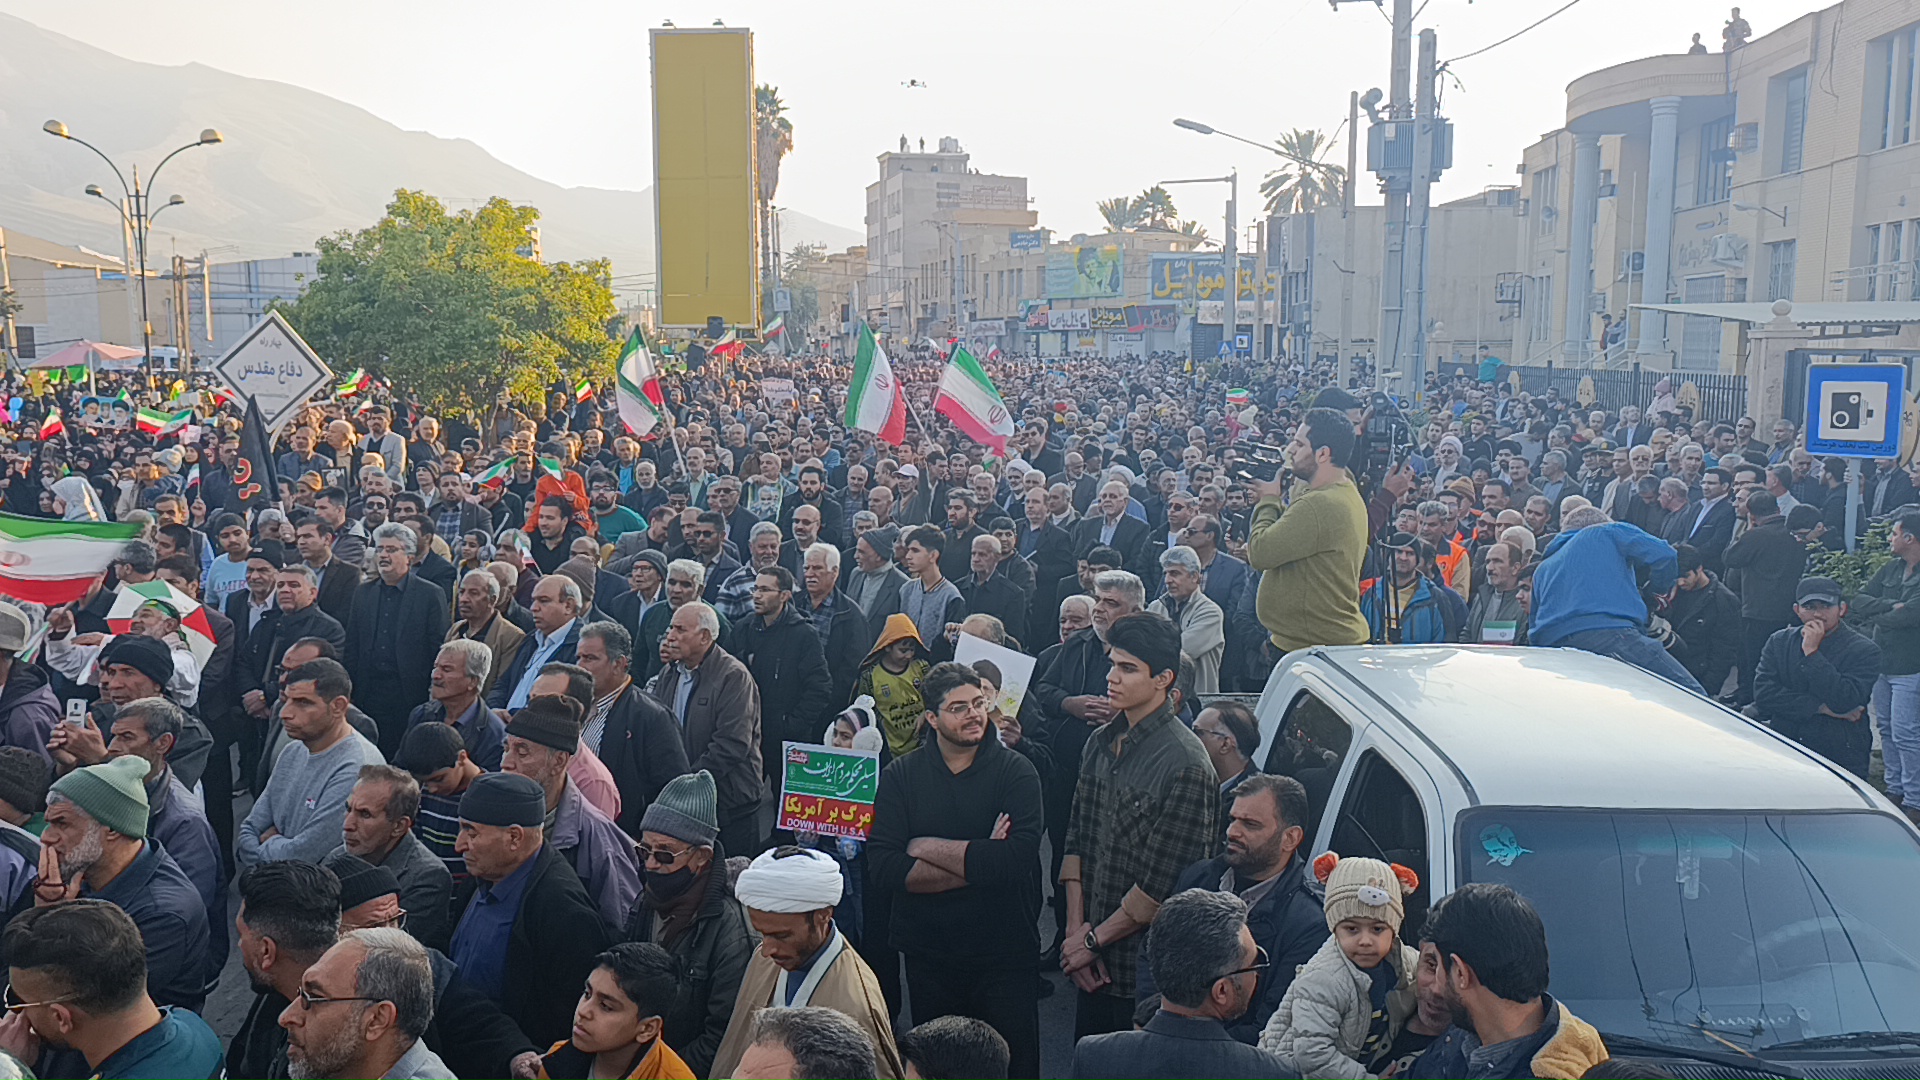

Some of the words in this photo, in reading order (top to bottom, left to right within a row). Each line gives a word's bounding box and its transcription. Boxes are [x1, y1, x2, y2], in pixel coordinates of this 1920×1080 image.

[1091, 306, 1123, 325] موبایل
[237, 361, 275, 381] مقدس
[278, 361, 303, 384] دفاع
[1838, 441, 1855, 449] تخلف
[1872, 444, 1897, 452] دوربین
[803, 757, 836, 783] ایران
[834, 762, 850, 785] مردم
[846, 757, 868, 789] محکم
[836, 768, 876, 797] سیلی
[785, 795, 824, 820] آمریکا
[826, 807, 839, 824] بر
[841, 804, 872, 828] مرگ
[786, 817, 815, 831] DOWN
[816, 821, 839, 834] WITH
[840, 825, 866, 837] U.S.A
